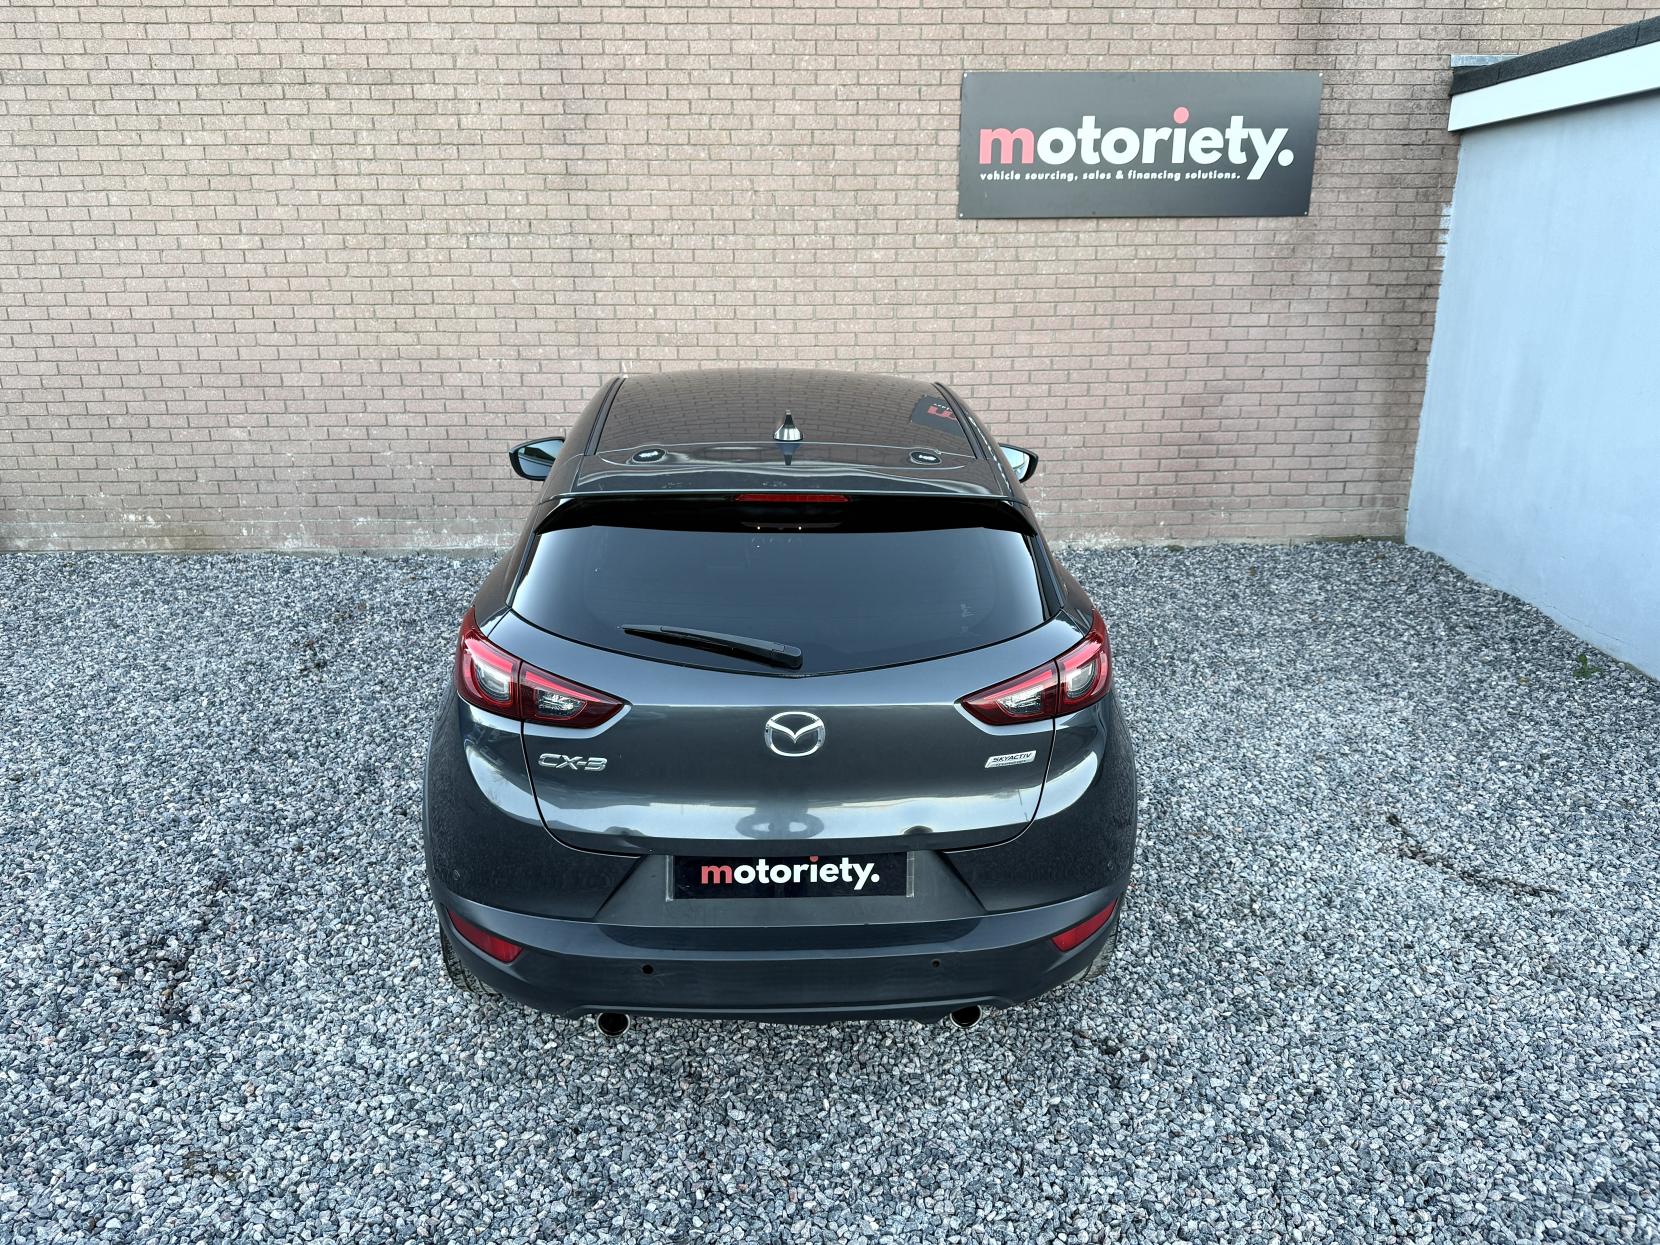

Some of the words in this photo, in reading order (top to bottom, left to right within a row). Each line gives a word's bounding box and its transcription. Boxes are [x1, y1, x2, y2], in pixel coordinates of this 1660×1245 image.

[979, 106, 1294, 180] motoriety.
[980, 170, 1021, 181] vehicle
[1024, 170, 1078, 182] sourcing,
[1082, 170, 1112, 180] sales
[1115, 170, 1124, 180] &
[1127, 170, 1181, 181] financing
[1185, 170, 1241, 180] solutions.
[538, 753, 608, 771] CX-3
[991, 753, 1032, 763] SKYACTIV
[701, 855, 880, 890] motoriety.
